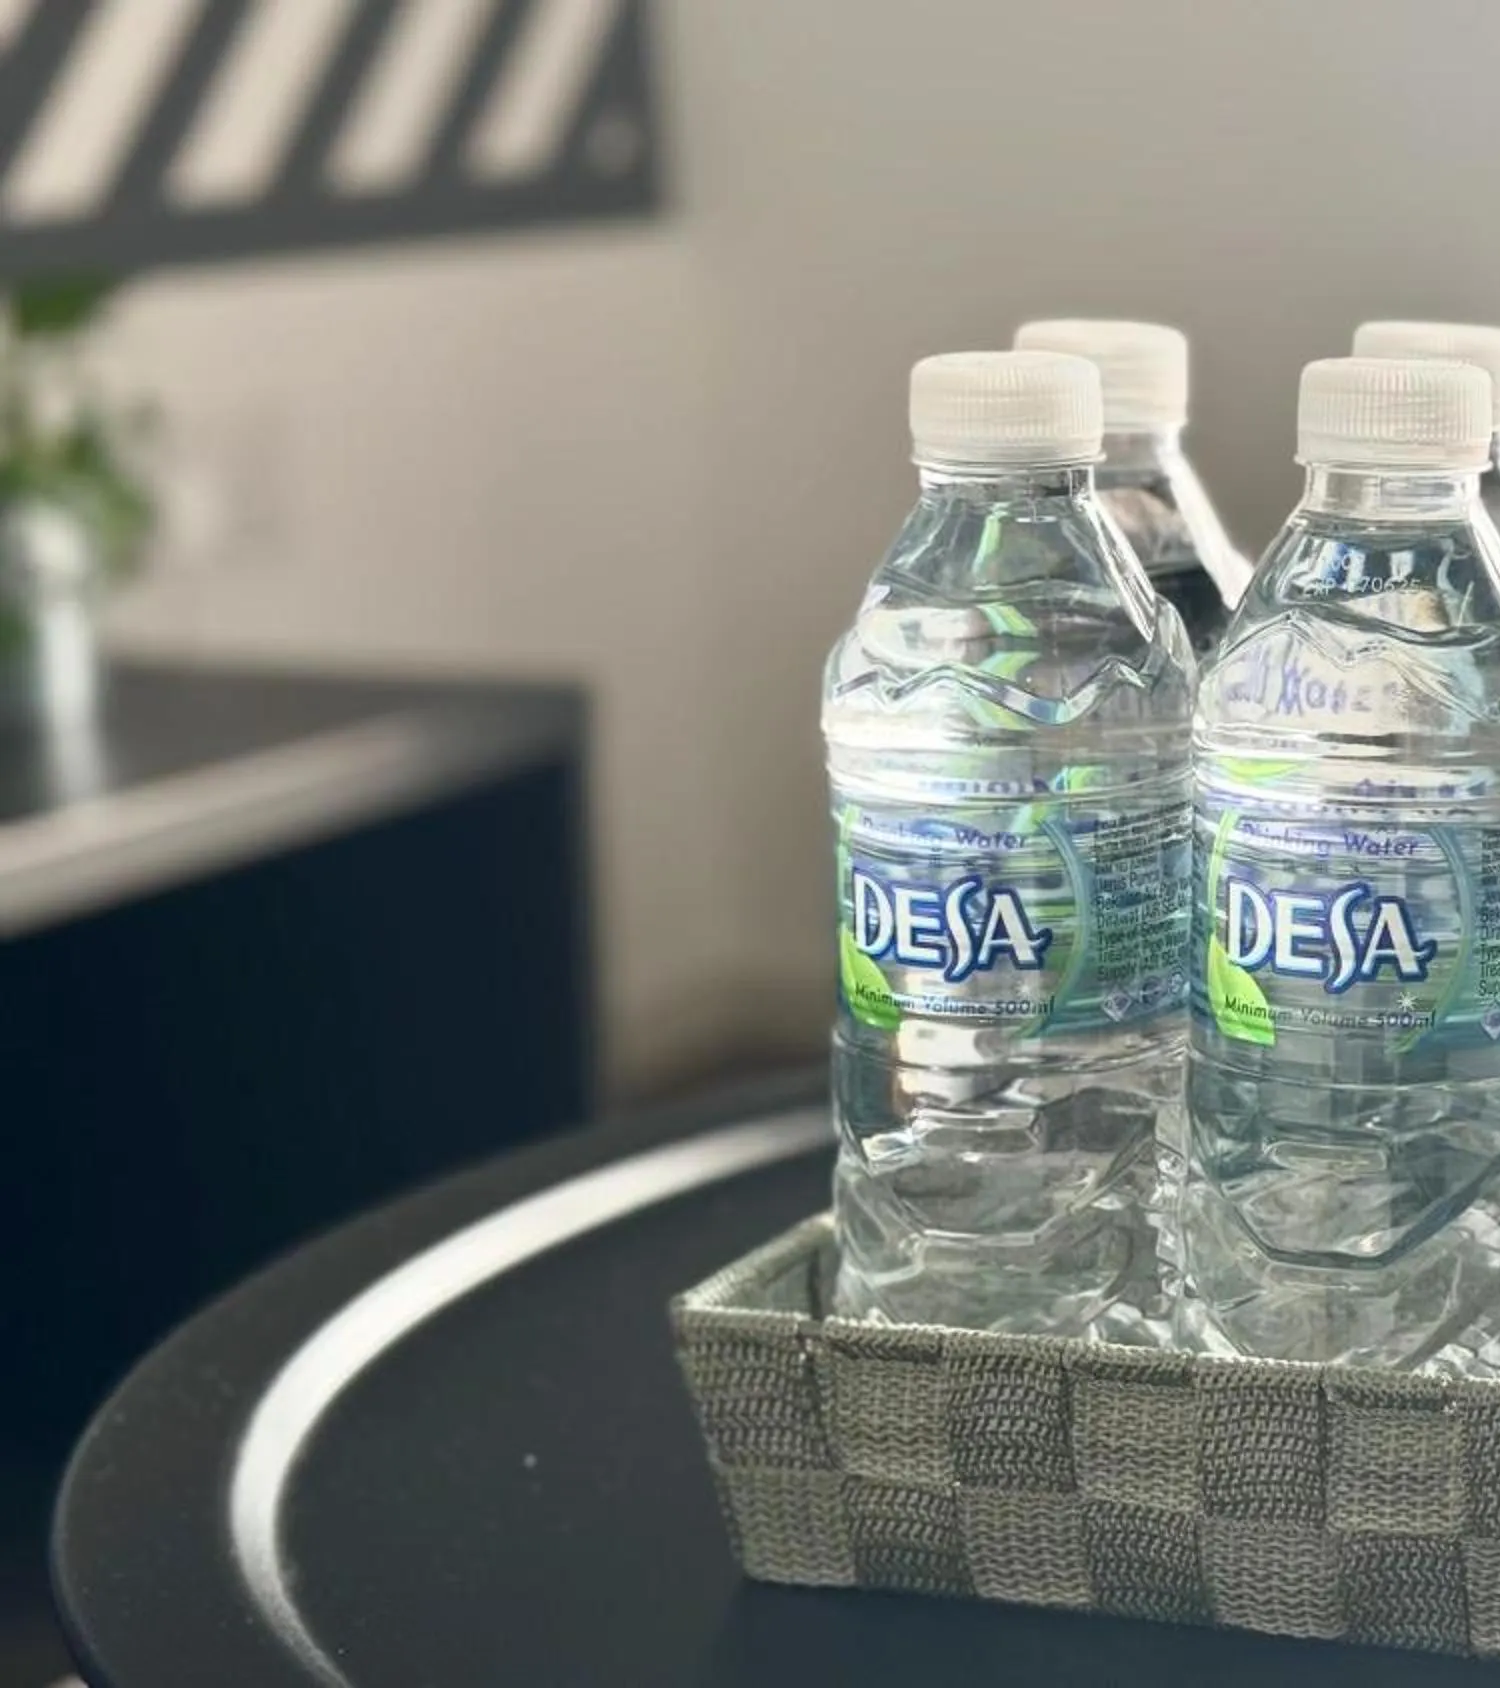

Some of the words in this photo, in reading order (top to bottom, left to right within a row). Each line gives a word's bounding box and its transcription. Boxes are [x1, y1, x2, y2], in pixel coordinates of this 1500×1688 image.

[955, 825, 1026, 849] Water
[1343, 831, 1418, 856] Water
[853, 867, 1053, 983] DESA
[1226, 875, 1438, 995] DESA
[923, 995, 986, 1015] Volume
[995, 995, 1055, 1016] 500ml
[1225, 994, 1293, 1021] Minimum
